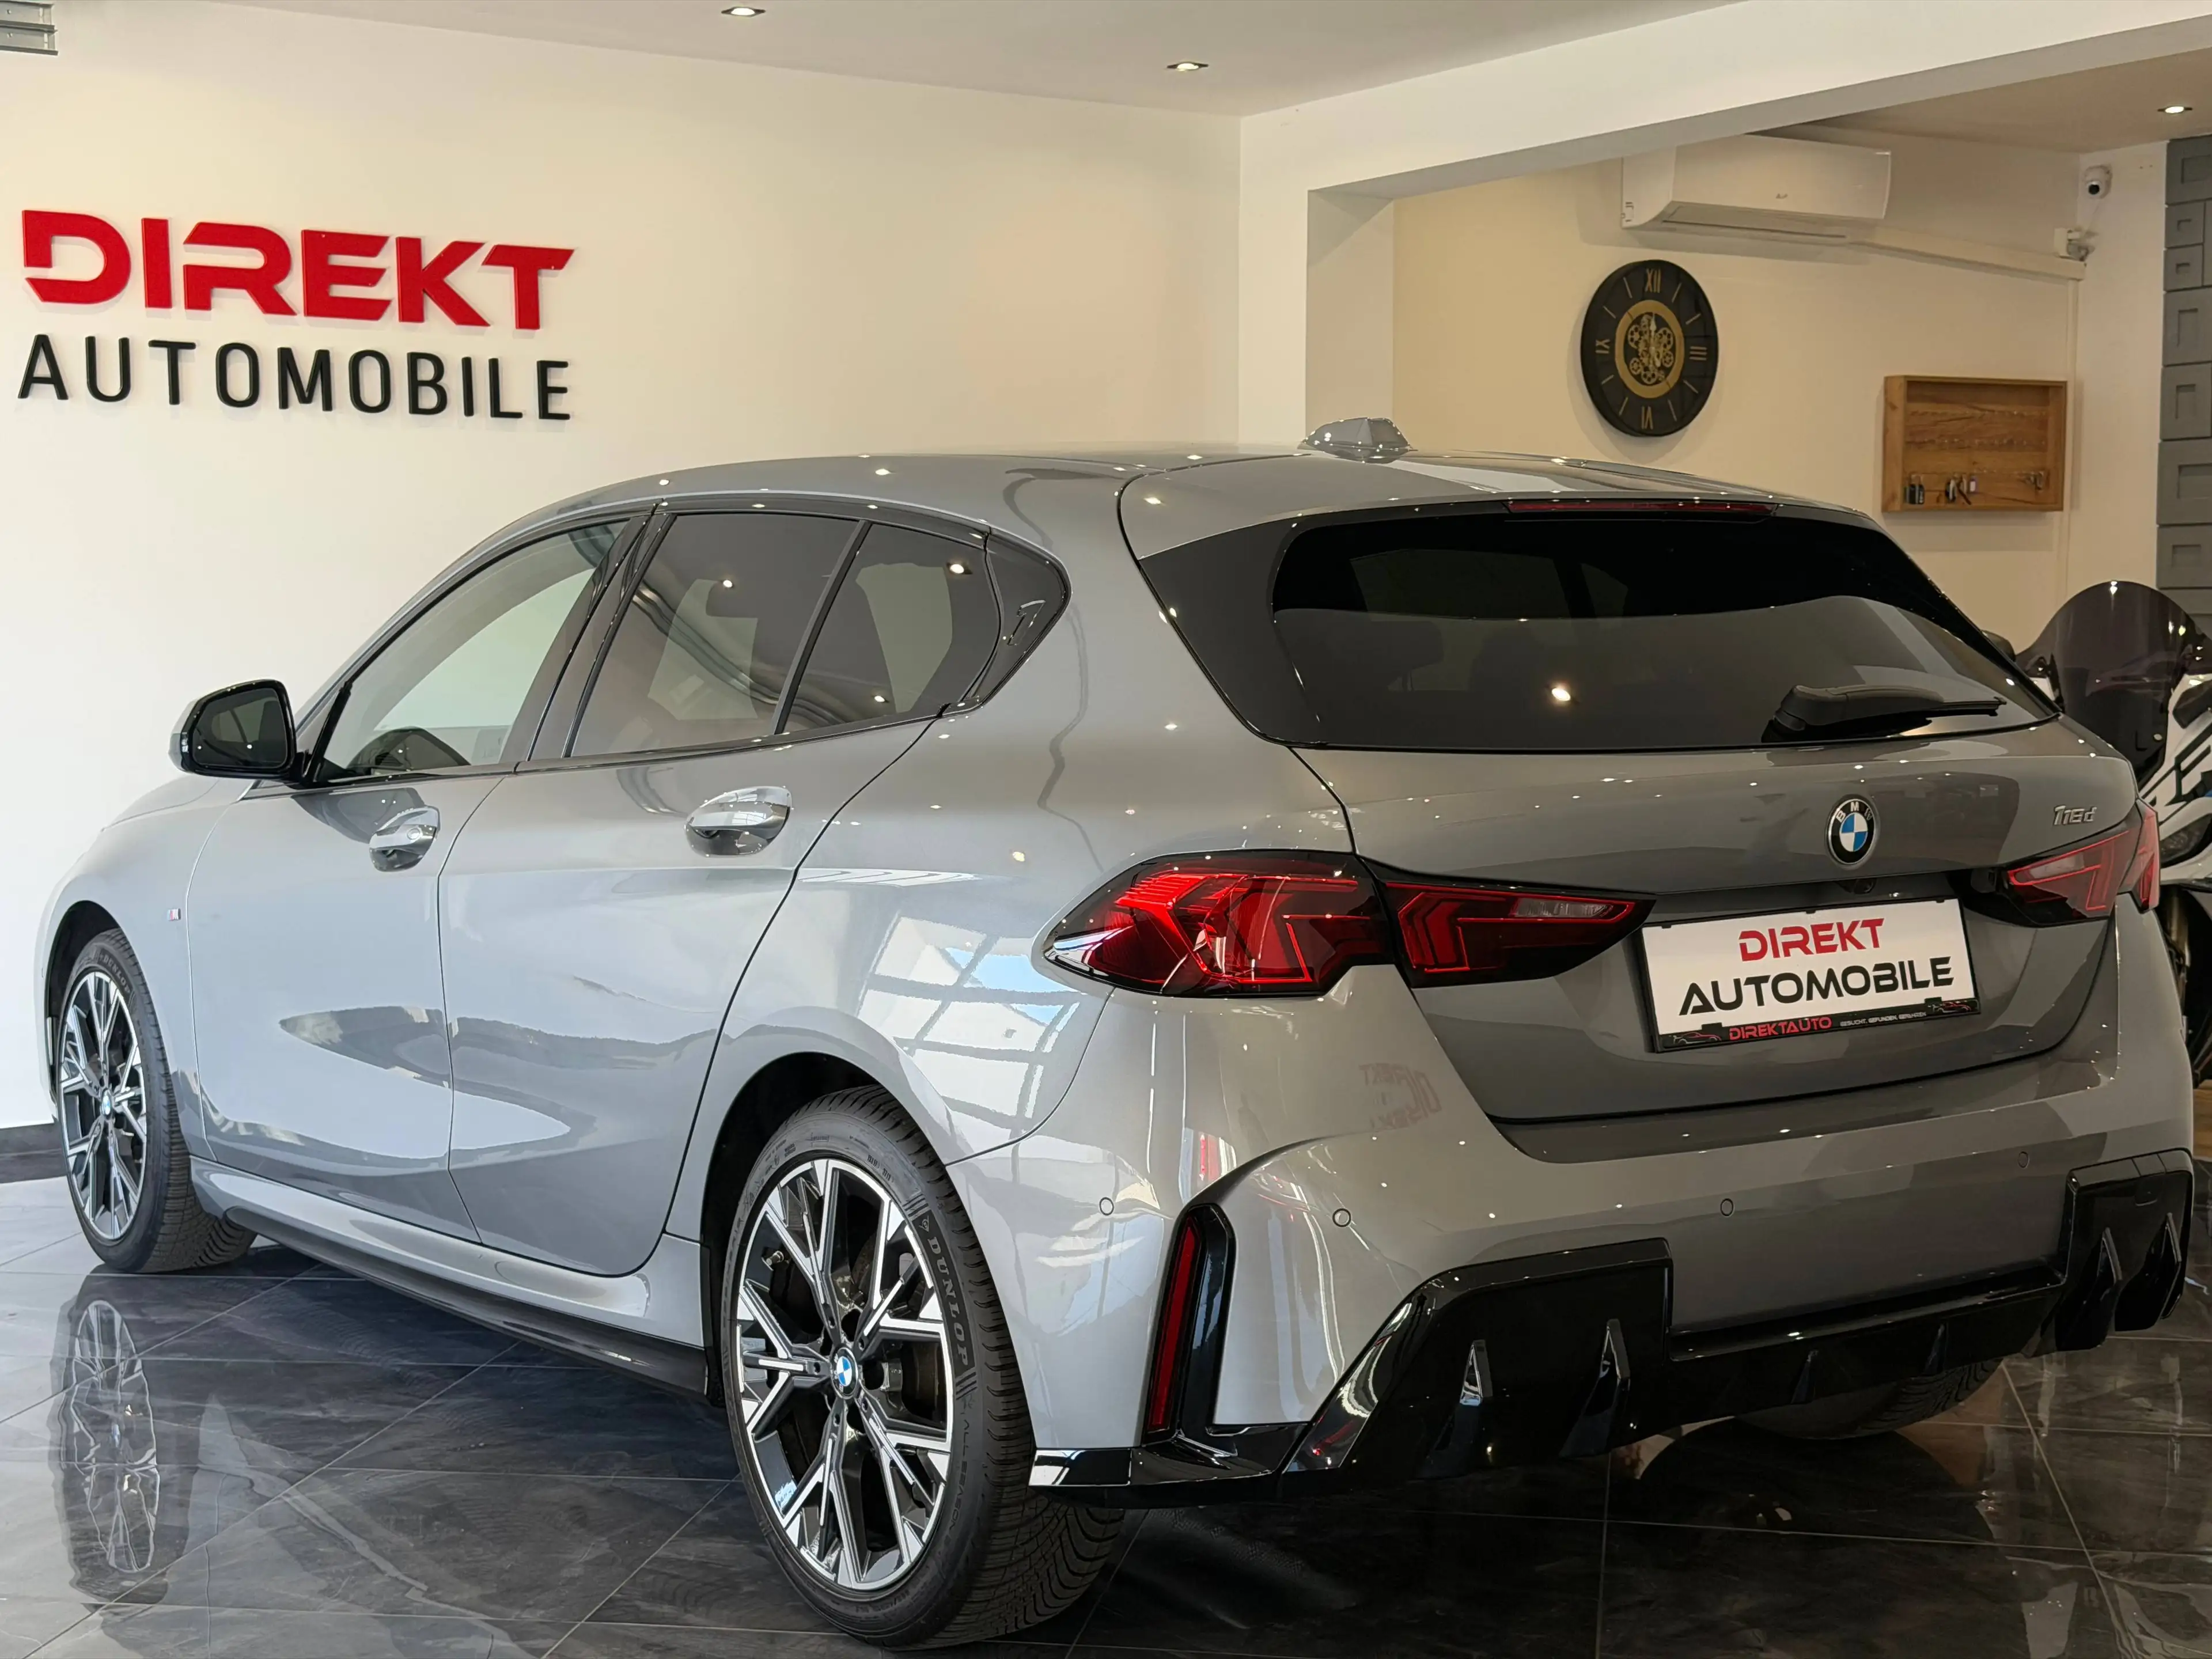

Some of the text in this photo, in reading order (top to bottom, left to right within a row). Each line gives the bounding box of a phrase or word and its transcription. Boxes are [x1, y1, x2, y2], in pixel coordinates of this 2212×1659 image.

[22, 209, 575, 330] DIREKT
[1645, 268, 1662, 293] XII
[17, 334, 572, 421] AUTOMOBILE
[1835, 801, 1874, 823] BMW
[1738, 918, 1884, 961] DIREKT
[1679, 956, 1955, 1016] AUTOMOBILE
[1729, 1017, 1832, 1040] DIREKTAUTO
[927, 1236, 968, 1365] DUNLOP
